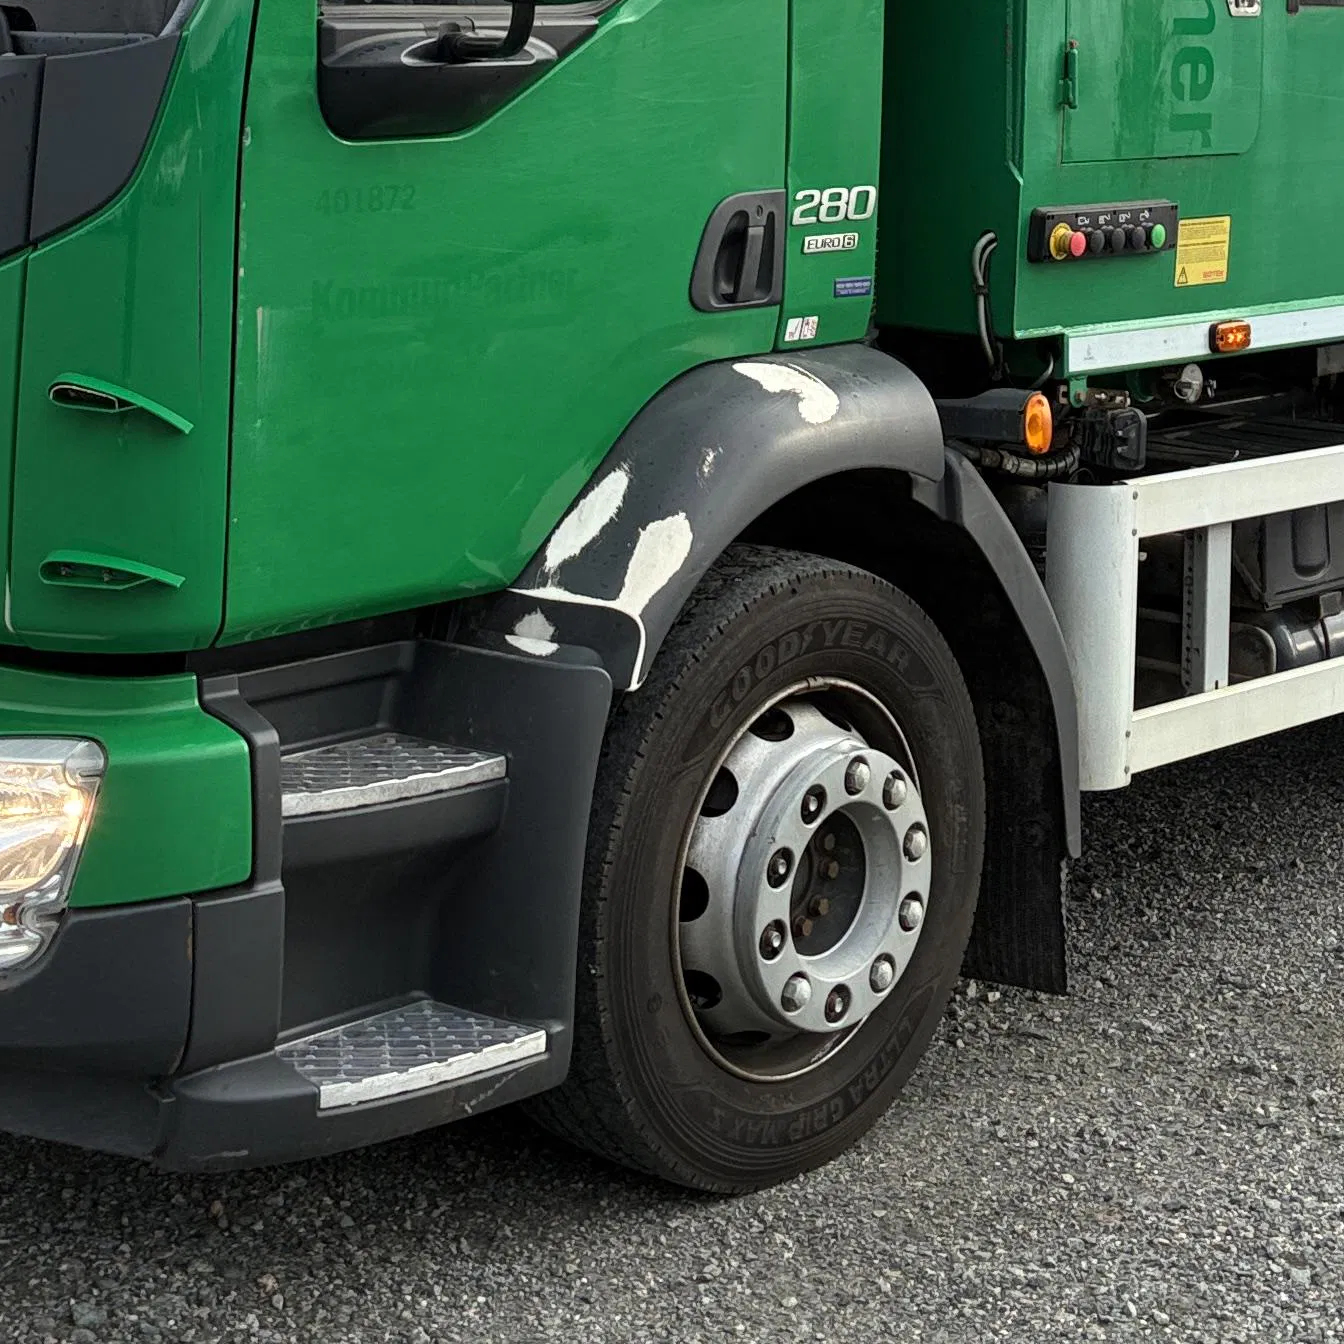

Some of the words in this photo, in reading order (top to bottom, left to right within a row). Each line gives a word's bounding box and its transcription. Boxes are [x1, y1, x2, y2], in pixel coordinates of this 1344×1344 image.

[315, 184, 416, 216] 401872
[792, 185, 877, 225] 280
[806, 237, 841, 250] EURO
